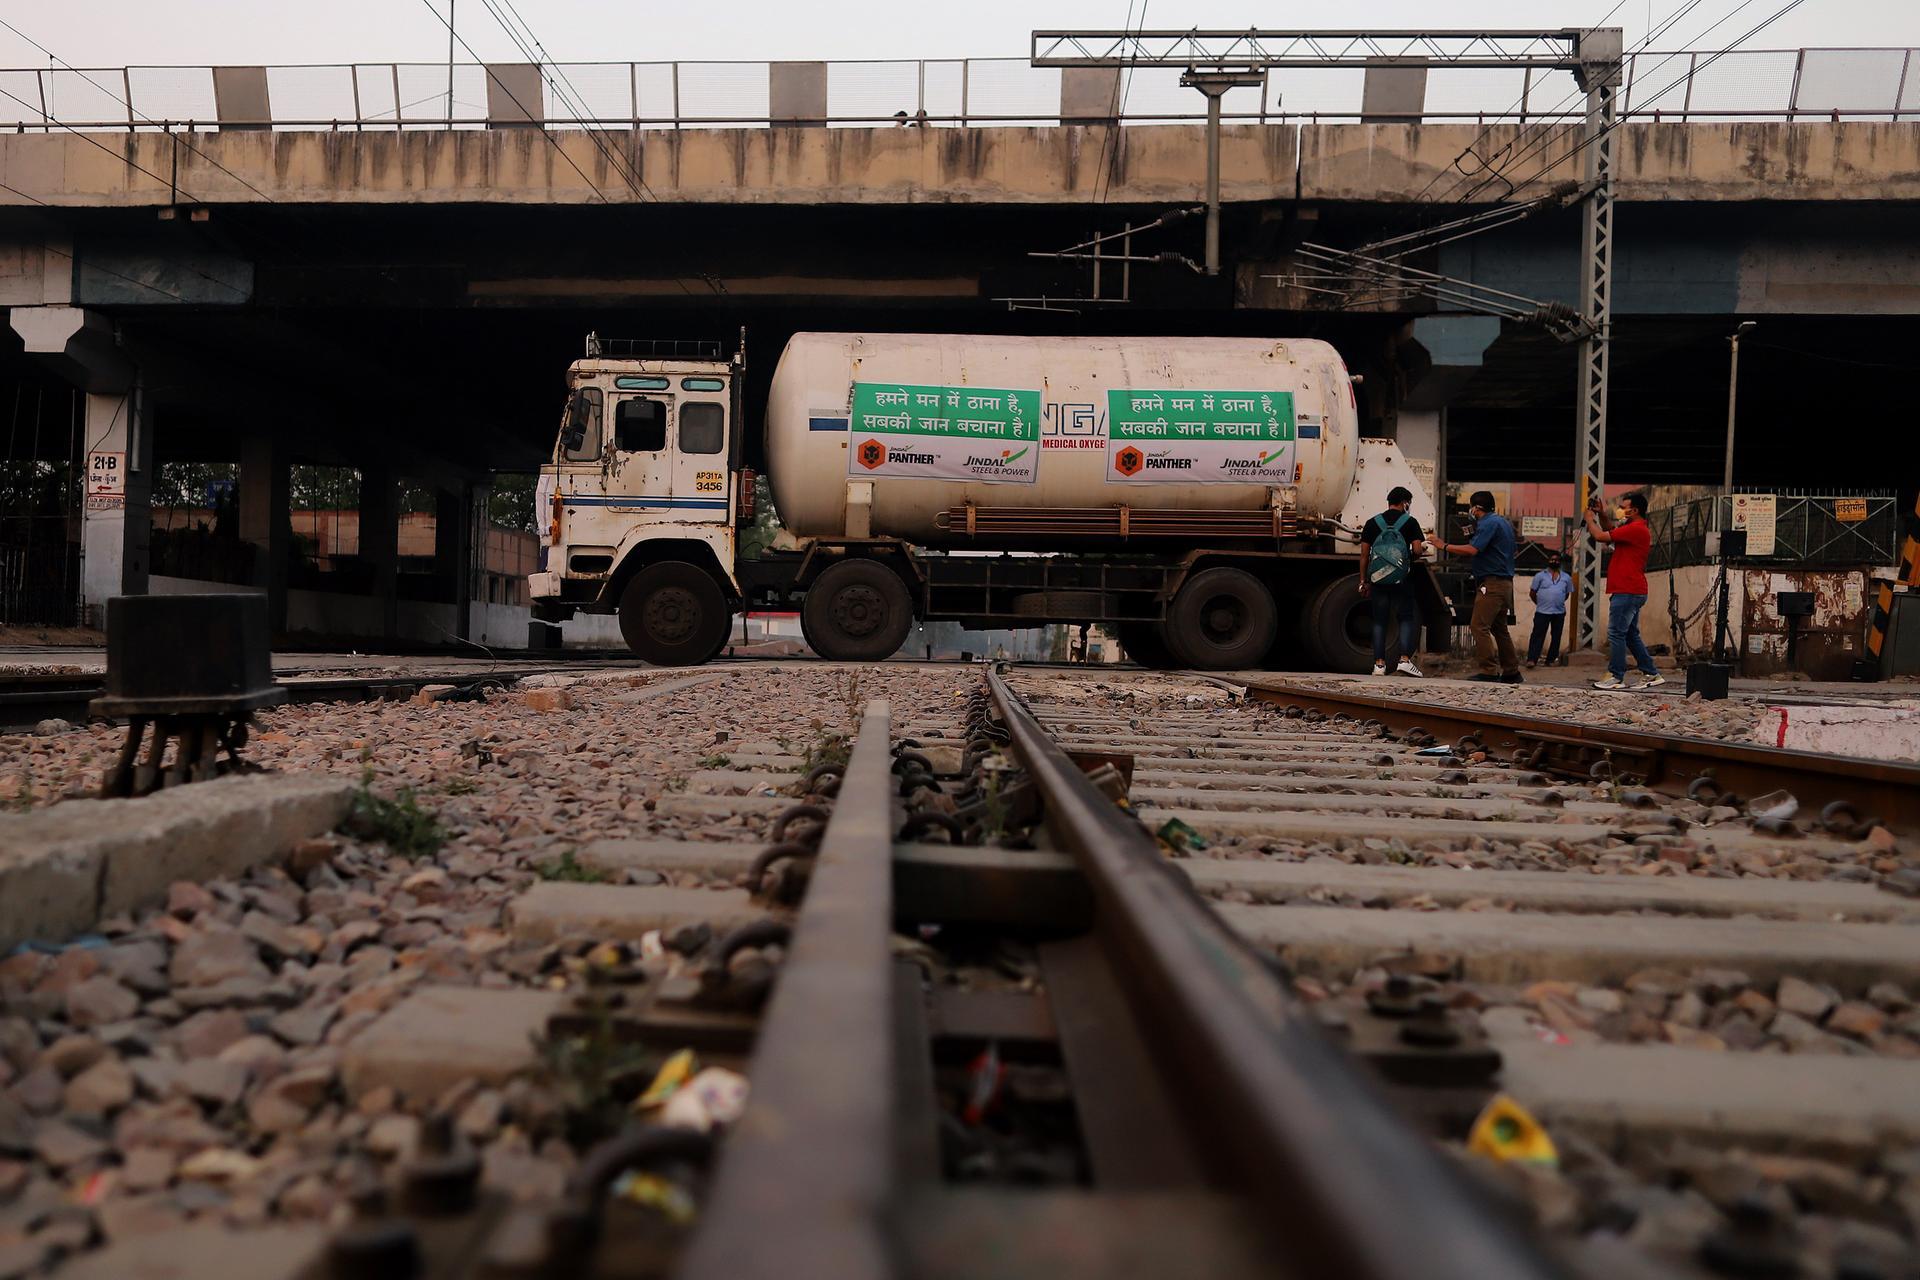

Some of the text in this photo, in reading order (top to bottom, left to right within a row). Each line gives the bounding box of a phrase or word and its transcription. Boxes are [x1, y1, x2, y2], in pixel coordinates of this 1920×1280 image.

[875, 388, 1023, 415] हमने मन में ठाना है,
[1131, 394, 1277, 416] हमने मन में ठाना है,
[863, 412, 911, 430] सबकी
[918, 418, 949, 431] जान
[957, 420, 1006, 434] बचाना
[1120, 417, 1168, 435] सबकी
[1174, 422, 1206, 435] जान
[1213, 422, 1261, 435] बचाना
[1042, 439, 1077, 448] MEDICAL
[888, 453, 934, 465] PANTHER
[963, 456, 1005, 467] JINDAL
[1146, 458, 1191, 469] PANTHER
[1220, 458, 1262, 469] JINDAL
[696, 472, 723, 480] AP31TA
[1001, 468, 1030, 476] POWER
[1259, 469, 1287, 477] POWER
[696, 481, 723, 491] 3456
